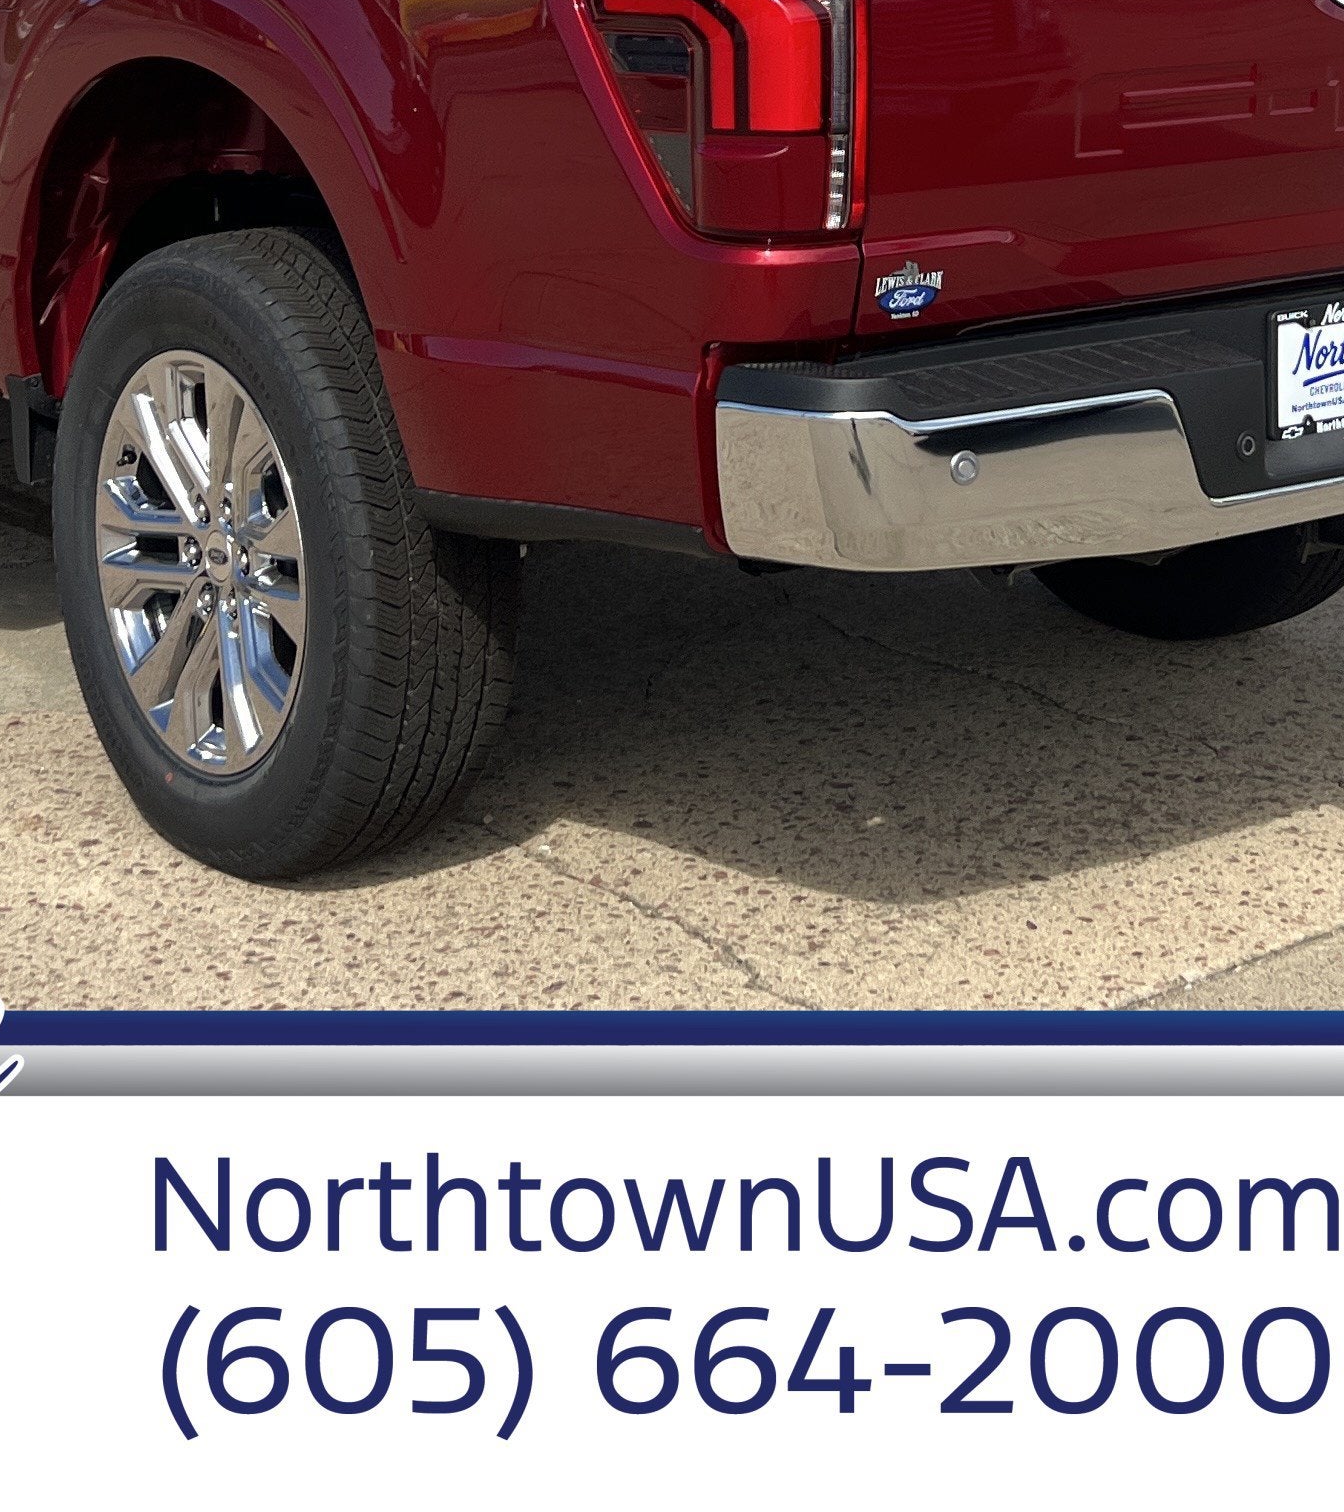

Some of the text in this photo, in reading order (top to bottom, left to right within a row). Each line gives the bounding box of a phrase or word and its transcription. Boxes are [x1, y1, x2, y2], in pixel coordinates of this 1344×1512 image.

[875, 275, 906, 297] LEWIS
[914, 270, 944, 290] CLARK
[889, 288, 926, 308] Ford
[1277, 310, 1309, 322] BUICK
